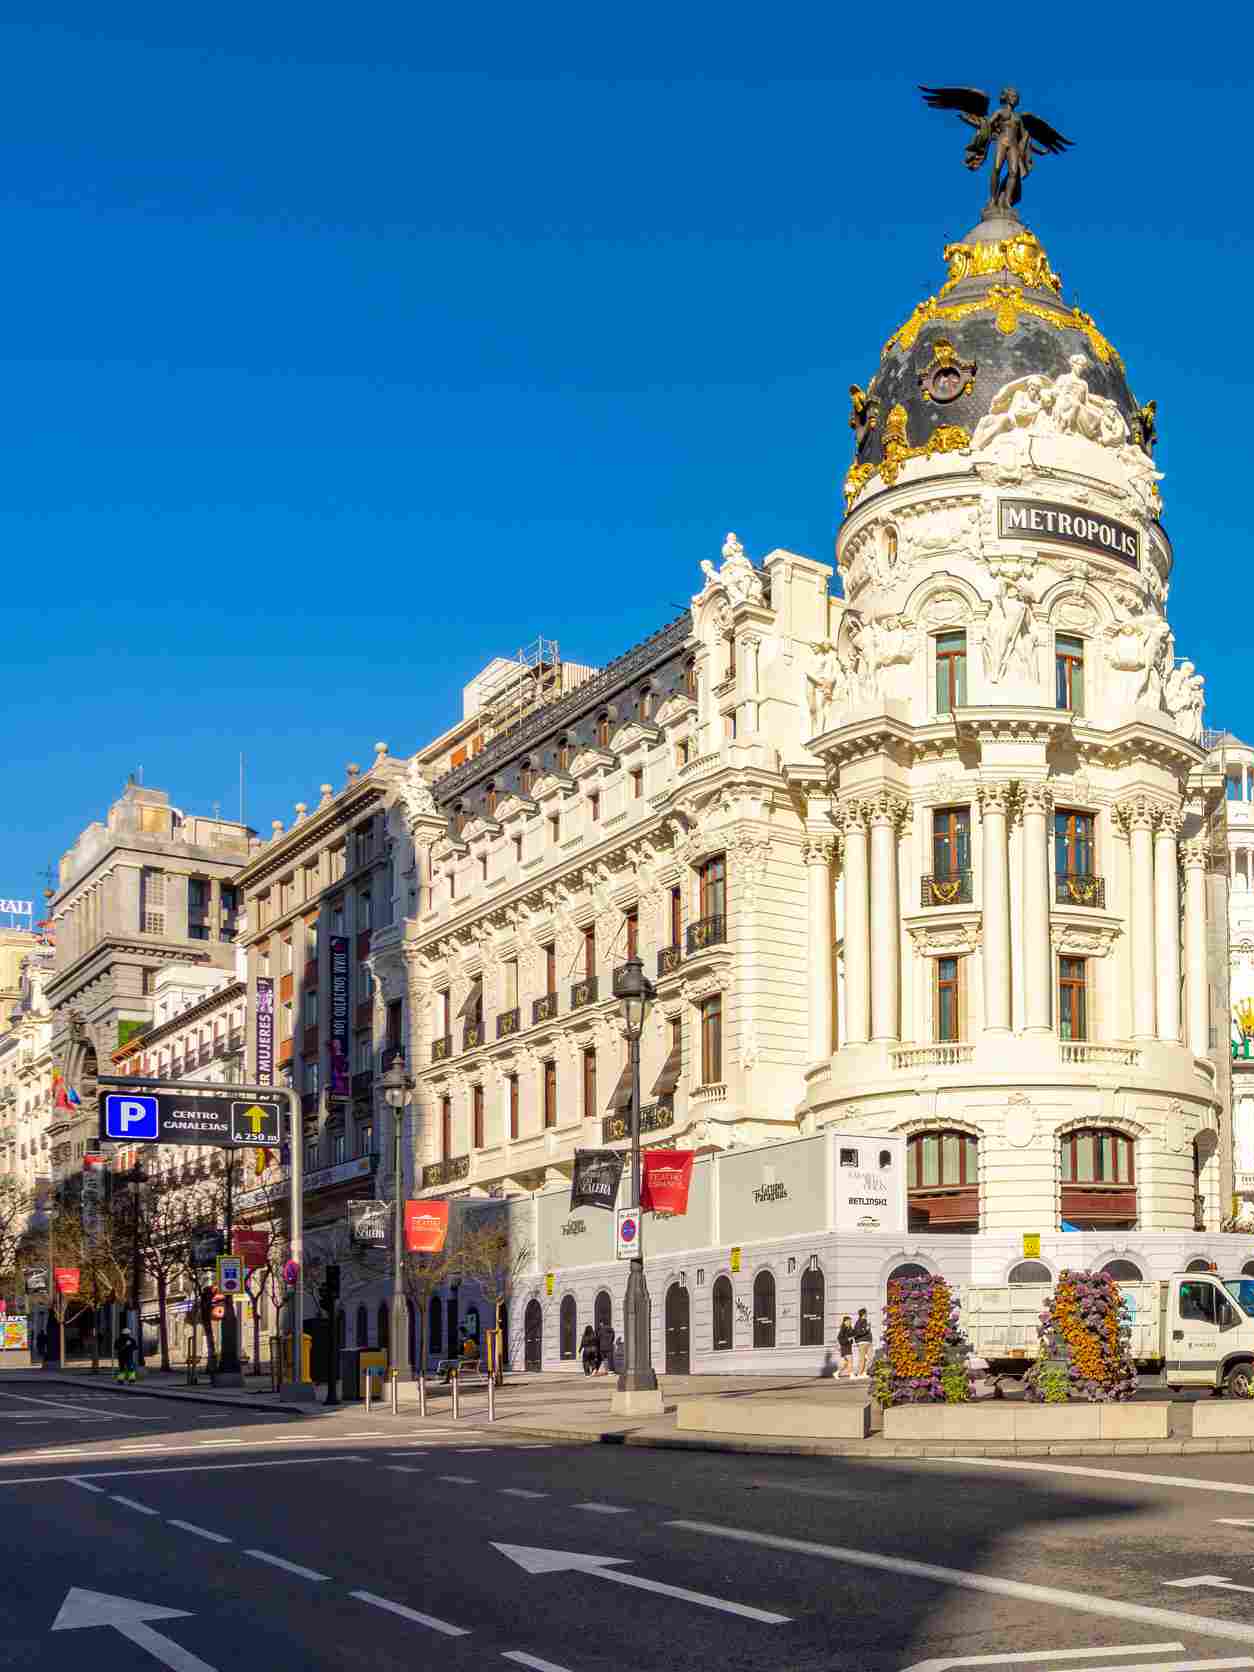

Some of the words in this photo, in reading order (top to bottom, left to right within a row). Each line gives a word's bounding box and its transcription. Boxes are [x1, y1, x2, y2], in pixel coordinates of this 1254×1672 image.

[1008, 508, 1135, 557] METROPOLIS
[259, 1012, 271, 1072] MUJERES
[120, 1101, 146, 1132] P
[163, 1121, 228, 1131] CANALEJAS
[172, 1110, 219, 1120] CENTRO
